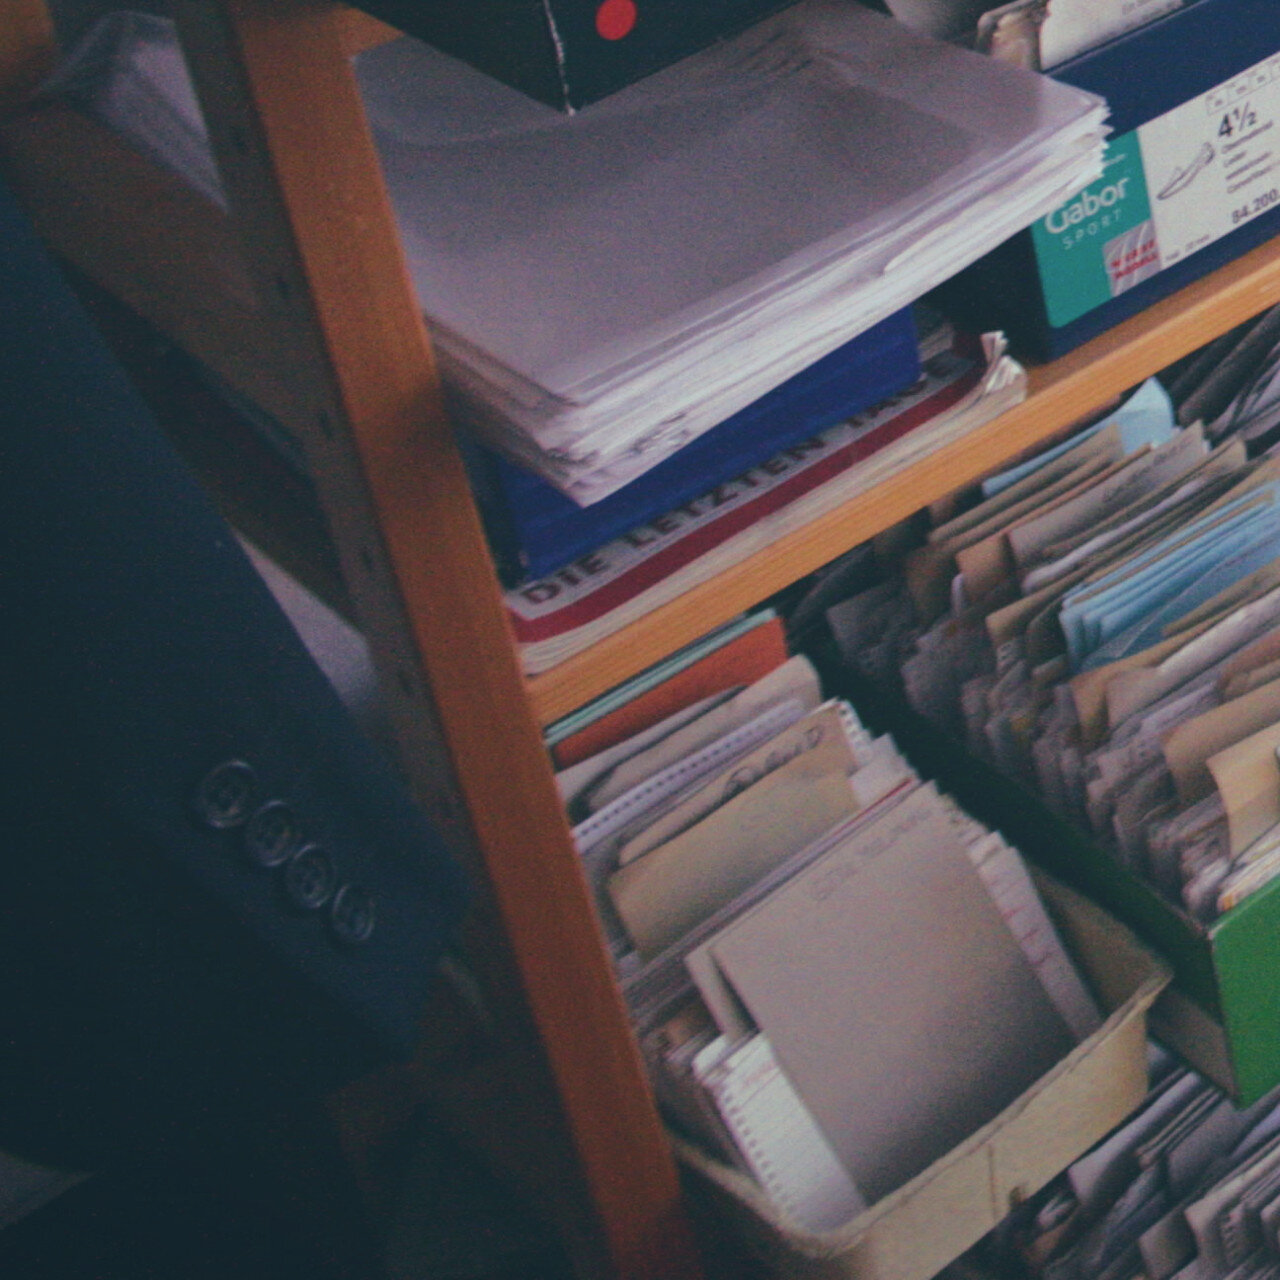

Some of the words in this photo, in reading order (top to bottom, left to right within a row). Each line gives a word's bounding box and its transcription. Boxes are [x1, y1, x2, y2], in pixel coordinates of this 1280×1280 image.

[1043, 175, 1132, 235] Gabor
[521, 553, 611, 605] DIE
[623, 434, 828, 549] LETZTEN
